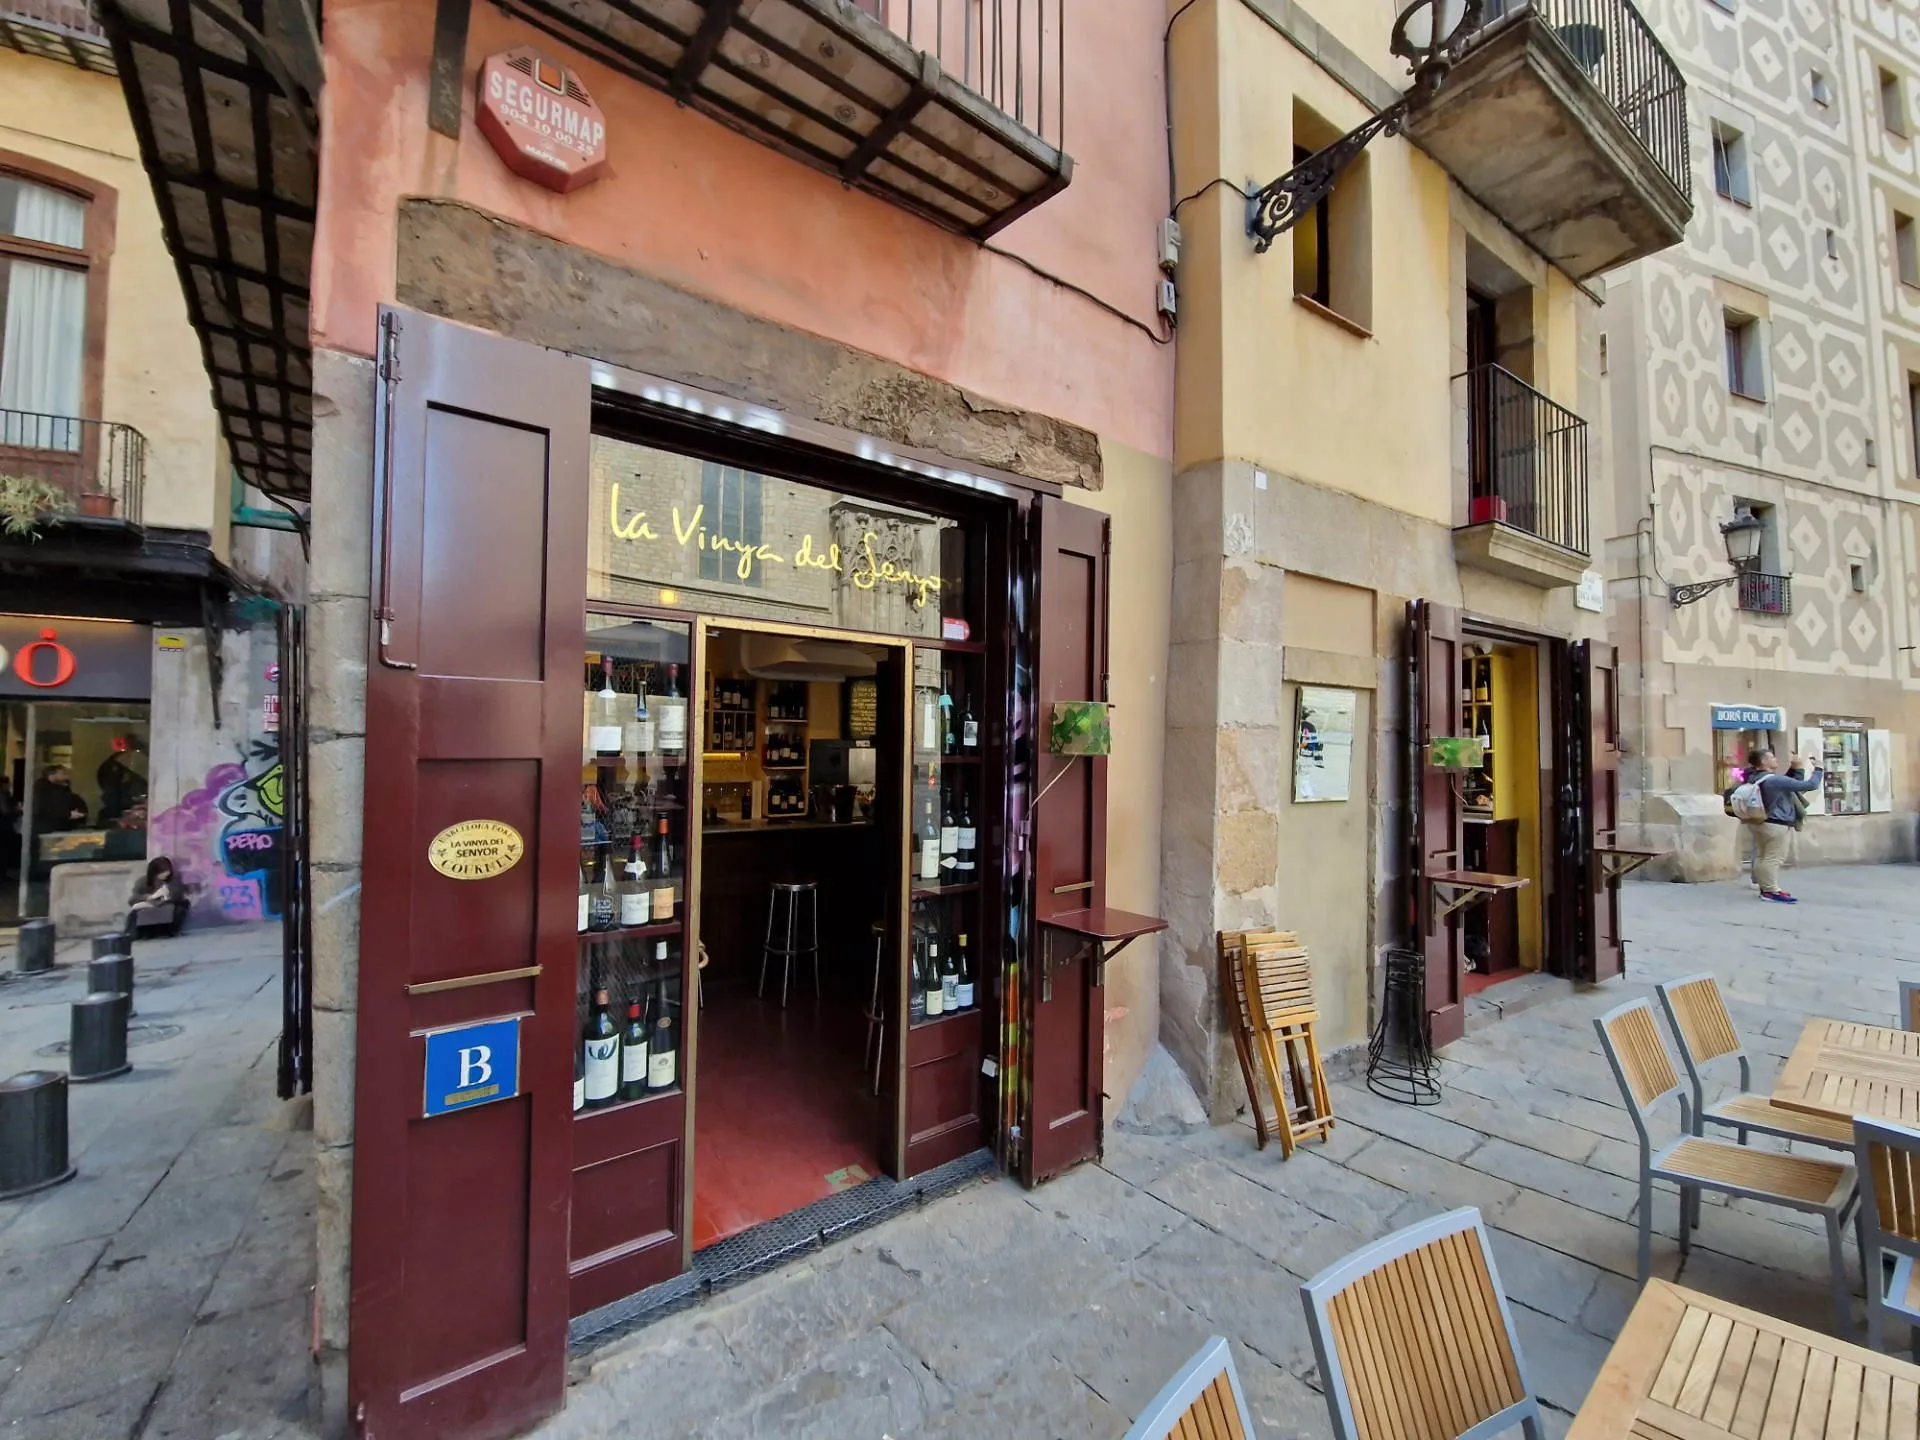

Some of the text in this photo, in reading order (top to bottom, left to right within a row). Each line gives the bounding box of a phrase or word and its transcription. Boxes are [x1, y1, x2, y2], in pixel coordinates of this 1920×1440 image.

[490, 71, 604, 147] SEGURMAP
[611, 483, 658, 539] La
[673, 504, 784, 580] Vinya
[795, 534, 843, 572] del
[1742, 711, 1760, 723] FOR
[1762, 712, 1777, 724] JOY
[451, 838, 504, 849] LA VINYA DEL
[456, 847, 499, 858] SENYOR
[456, 1045, 493, 1089] B
